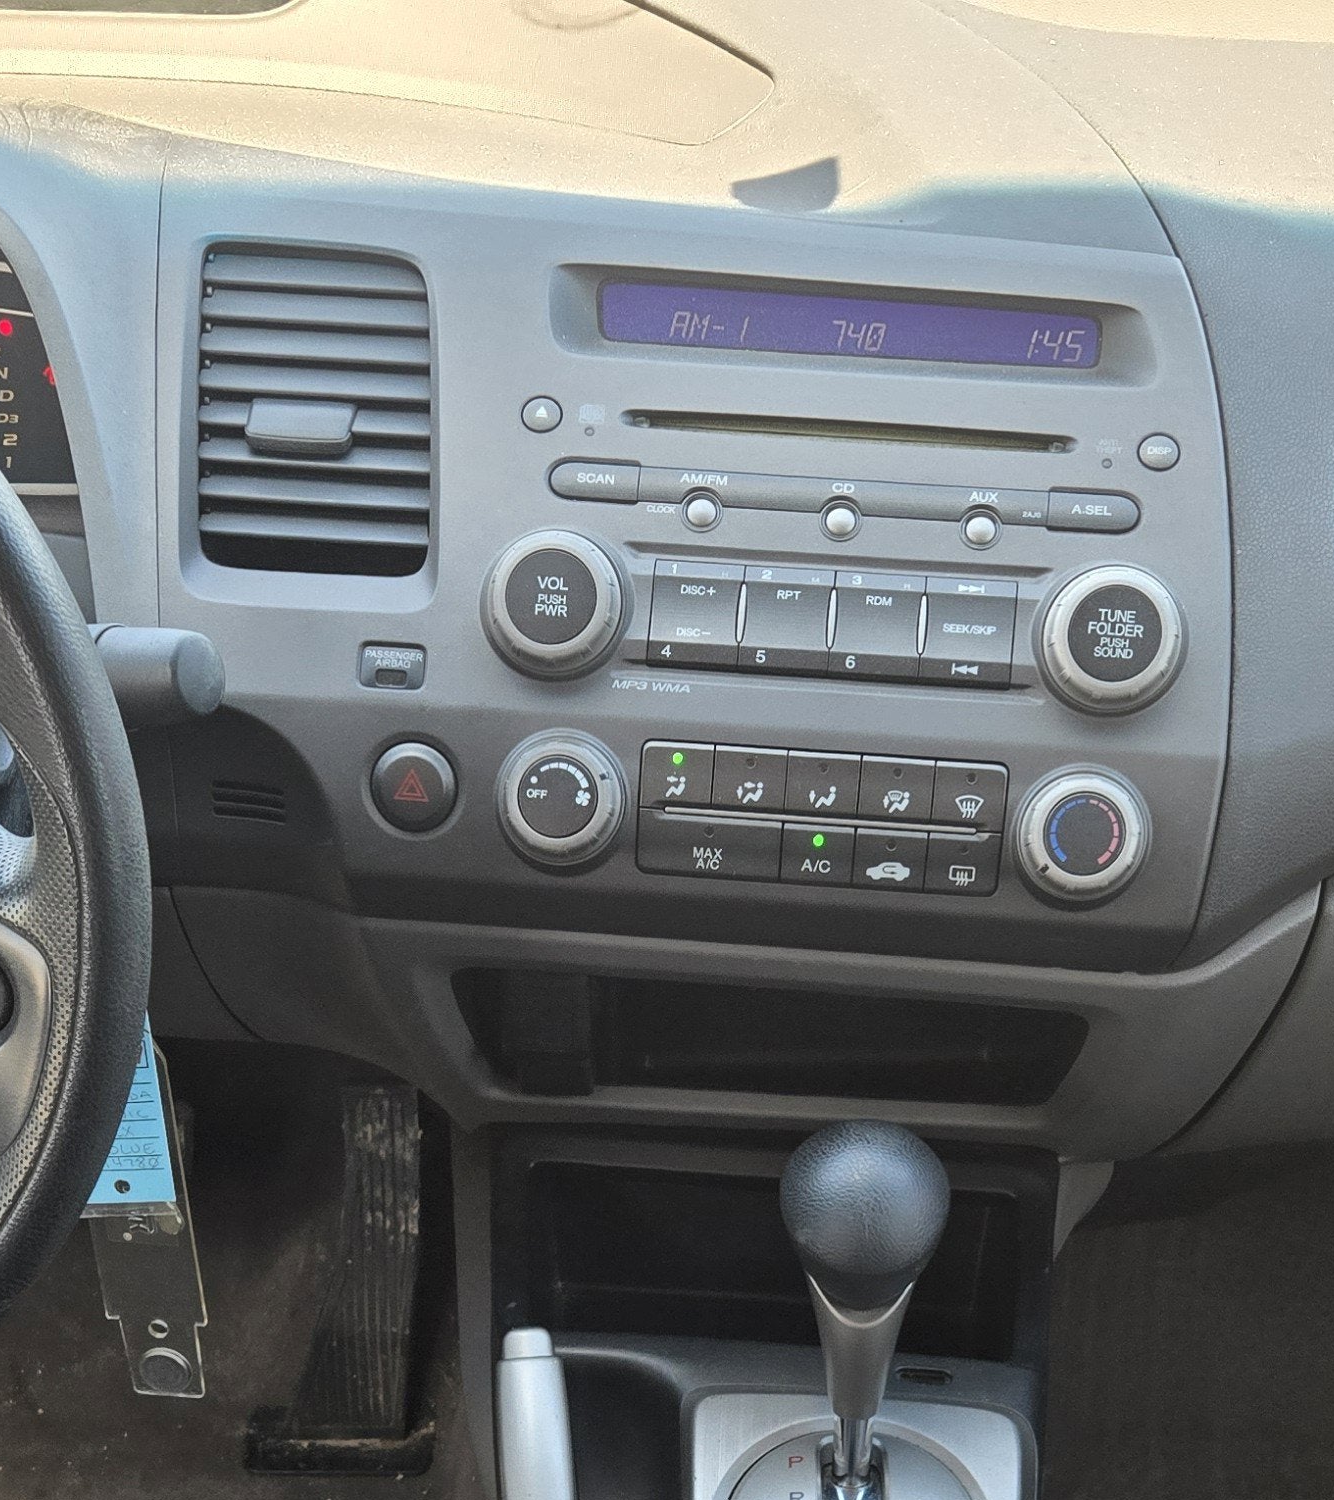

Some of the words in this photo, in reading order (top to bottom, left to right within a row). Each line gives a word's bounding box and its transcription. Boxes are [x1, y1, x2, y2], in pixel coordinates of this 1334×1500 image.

[831, 320, 887, 352] 740
[1026, 327, 1086, 363] 1:45
[2, 433, 18, 446] 2
[1147, 446, 1173, 455] DISP
[5, 456, 12, 469] 1
[576, 472, 616, 486] SCAN
[679, 472, 729, 486] AM/FM
[831, 482, 855, 494] CD
[969, 490, 999, 503] AUX
[646, 504, 677, 515] CLOCK
[1071, 504, 1113, 517] A.SEL
[671, 563, 678, 574] 1
[760, 569, 773, 580] 2
[536, 575, 569, 591] VOL
[851, 575, 863, 586] 3
[537, 593, 567, 605] PUSH
[776, 589, 802, 601] RPT
[865, 595, 893, 607] RDM
[534, 603, 568, 618] PWR
[1098, 608, 1137, 624] TUNE
[942, 622, 997, 636] SEEK/SKIP
[1087, 621, 1145, 638] FOLDER
[1099, 636, 1130, 648] PUSH
[364, 649, 424, 662] PASSENGER
[660, 644, 672, 658] 4
[755, 650, 766, 664] 5
[1093, 645, 1134, 659] SOUND
[374, 659, 412, 669] AIRBAG
[845, 655, 856, 669] 6
[611, 679, 648, 691] MP3
[651, 682, 691, 693] WMA
[526, 788, 548, 799] OFF
[692, 846, 723, 860] MAX
[695, 858, 720, 871] A/C
[800, 858, 832, 874] A/C
[788, 1455, 805, 1469] P
